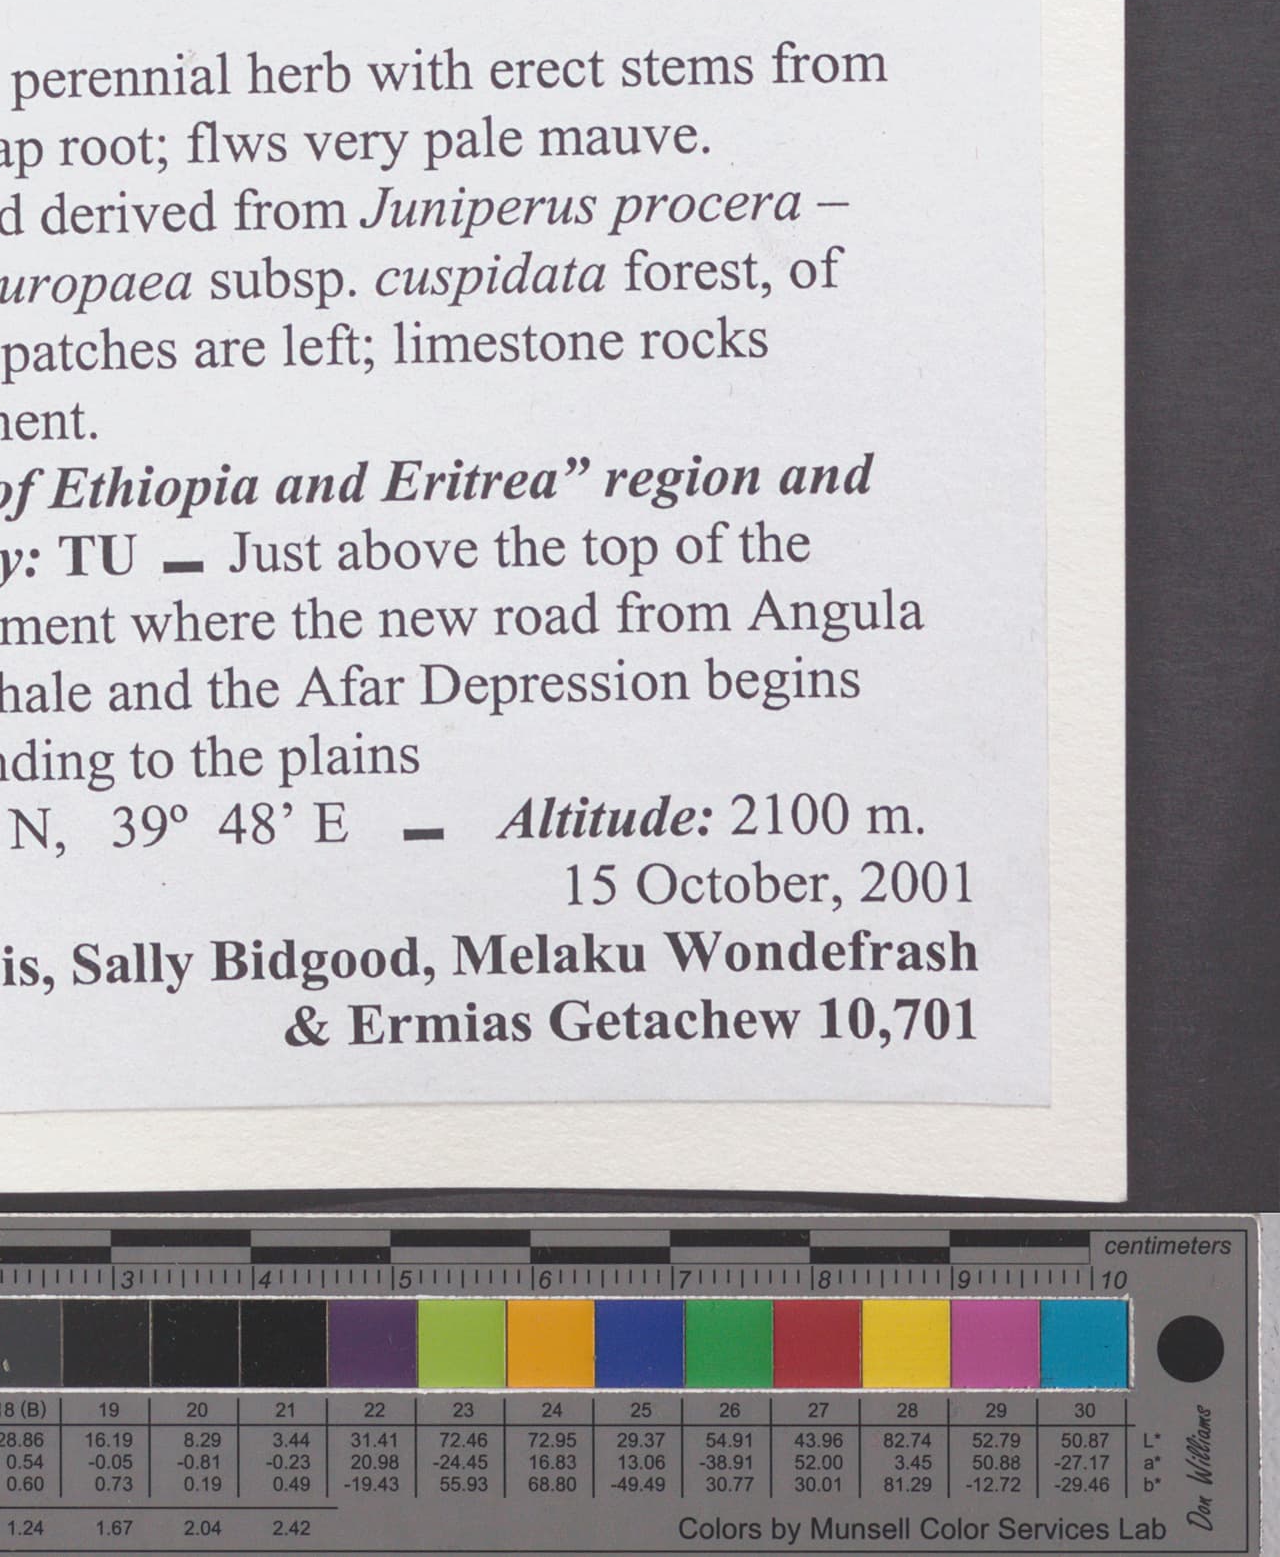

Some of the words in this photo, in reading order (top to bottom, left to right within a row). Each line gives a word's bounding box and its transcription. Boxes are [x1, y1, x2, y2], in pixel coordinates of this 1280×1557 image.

[10, 51, 232, 112] perennial
[246, 49, 351, 95] herb
[366, 46, 474, 93] with
[489, 50, 605, 90] erect
[621, 49, 754, 88] stems
[771, 40, 889, 84] from
[58, 127, 168, 175] root;
[186, 120, 288, 164] flws
[303, 130, 410, 172] very
[423, 114, 523, 172] pale
[538, 124, 711, 157] mauve.
[40, 188, 218, 236] derived
[233, 187, 348, 231] from
[359, 186, 598, 239] Juniperus
[607, 191, 802, 237] procera
[210, 255, 357, 311] subsp.
[375, 250, 607, 308] cuspidata
[623, 248, 772, 299] forest,
[789, 244, 846, 290] of
[0, 326, 178, 386] patches
[194, 337, 266, 369] are
[282, 322, 375, 375] left;
[393, 320, 625, 365] limestone
[639, 314, 769, 360] rocks
[46, 463, 259, 520] Ethiopia
[275, 460, 369, 506] and
[604, 454, 761, 510] region
[778, 451, 875, 496] and
[58, 533, 138, 577] TU
[228, 531, 322, 574] Just
[337, 526, 479, 572] above
[493, 523, 566, 569] the
[581, 528, 659, 578] top
[675, 520, 731, 565] of
[738, 519, 811, 564] the
[129, 598, 276, 643] where
[291, 596, 363, 641] the
[378, 607, 479, 639] new
[493, 590, 601, 637] road
[615, 589, 732, 634] from
[746, 587, 926, 643] Angula
[108, 666, 193, 713] and
[206, 665, 280, 710] the
[295, 663, 406, 708] Afar
[419, 658, 691, 717] Depression
[703, 655, 861, 712] begins
[129, 742, 174, 780] to
[189, 734, 264, 779] the
[278, 731, 420, 789] plains
[312, 801, 349, 844] E
[495, 793, 713, 840] Altitude:
[730, 792, 850, 836] 2100
[865, 804, 925, 836] m.
[566, 863, 617, 906] 15
[636, 859, 843, 913] October,
[859, 860, 973, 904] 2001
[72, 941, 195, 995] Sally
[209, 935, 436, 992] Bidgood,
[451, 932, 647, 976] Melaku
[662, 928, 979, 973] Wondefrash
[284, 1004, 331, 1048] &
[347, 1001, 533, 1046] Ermias
[549, 998, 802, 1042] Getachew
[818, 996, 977, 1050] 10,701
[1104, 1235, 1232, 1256] centimeters
[1186, 1405, 1211, 1484] Williams
[678, 1516, 764, 1541] Colors
[771, 1516, 801, 1546] by
[810, 1515, 911, 1541] Munsell
[920, 1515, 990, 1541] Color
[998, 1515, 1110, 1541] Services
[1118, 1516, 1167, 1541] Lab
[1186, 1488, 1214, 1531] Don
